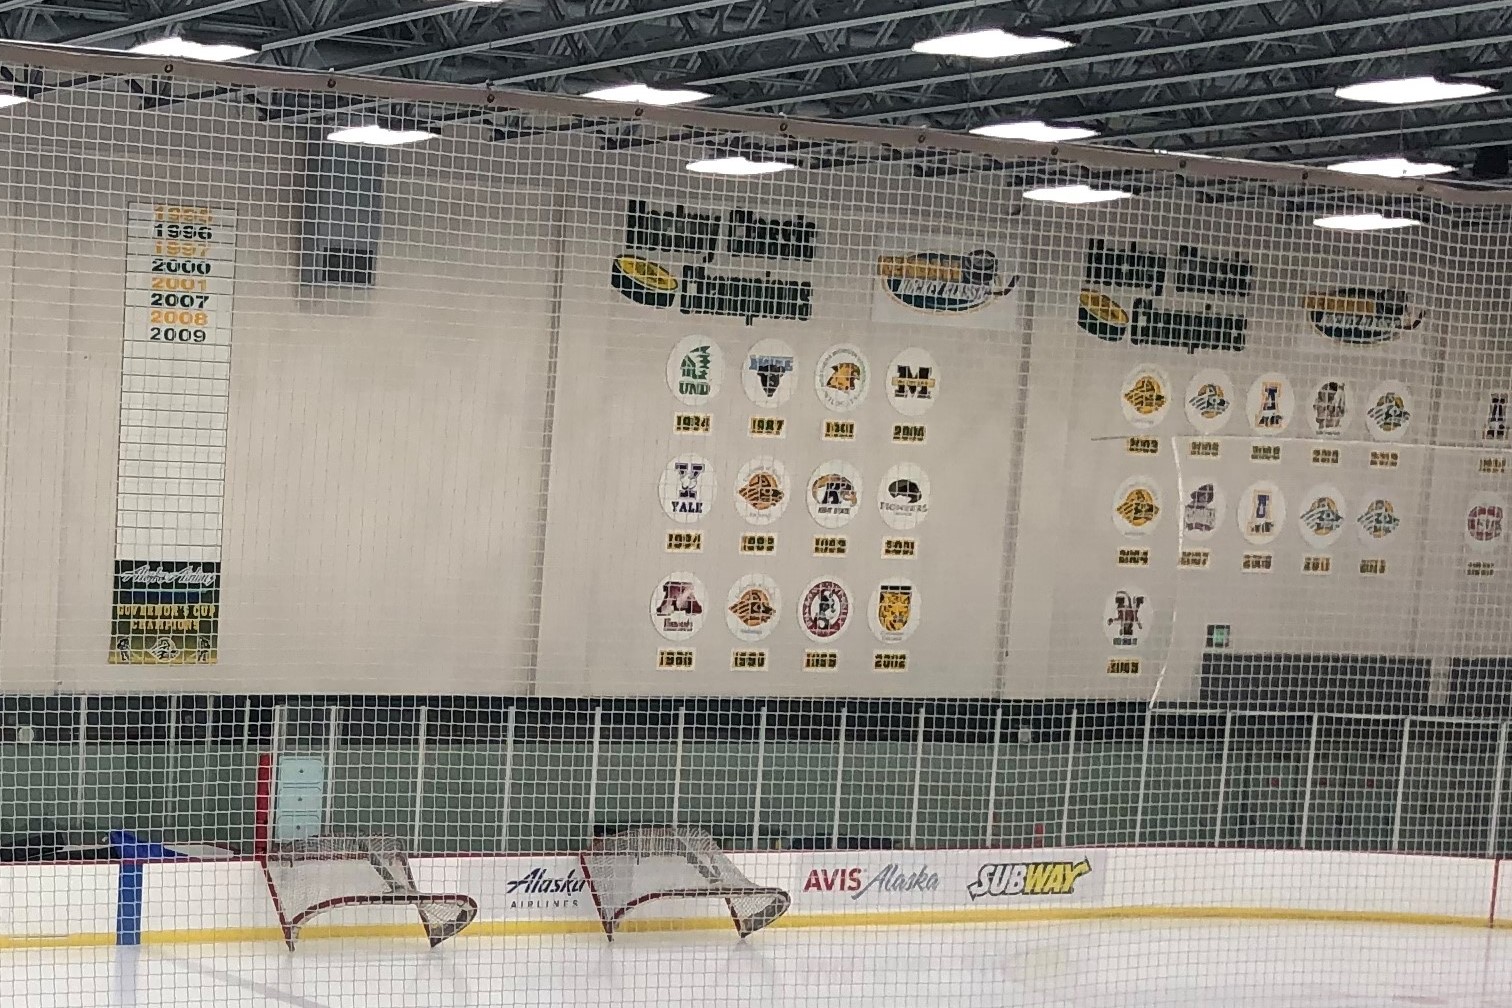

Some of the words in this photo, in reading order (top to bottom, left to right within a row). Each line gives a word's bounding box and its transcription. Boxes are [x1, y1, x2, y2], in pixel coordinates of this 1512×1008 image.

[154, 223, 212, 239] 1996
[154, 241, 210, 257] 1997
[151, 259, 211, 275] 2000
[151, 277, 207, 291] 2001
[150, 293, 209, 309] 2007
[150, 310, 208, 326] 2008
[149, 327, 206, 342] 2009
[678, 381, 711, 396] UND
[672, 501, 703, 513] YALE
[192, 605, 216, 617] CUP
[507, 867, 586, 896] Alaska
[803, 868, 862, 892] AVIS
[851, 864, 939, 900] Alaska
[968, 856, 1092, 901] SUBWAY
[510, 900, 579, 909] AIRLINES
